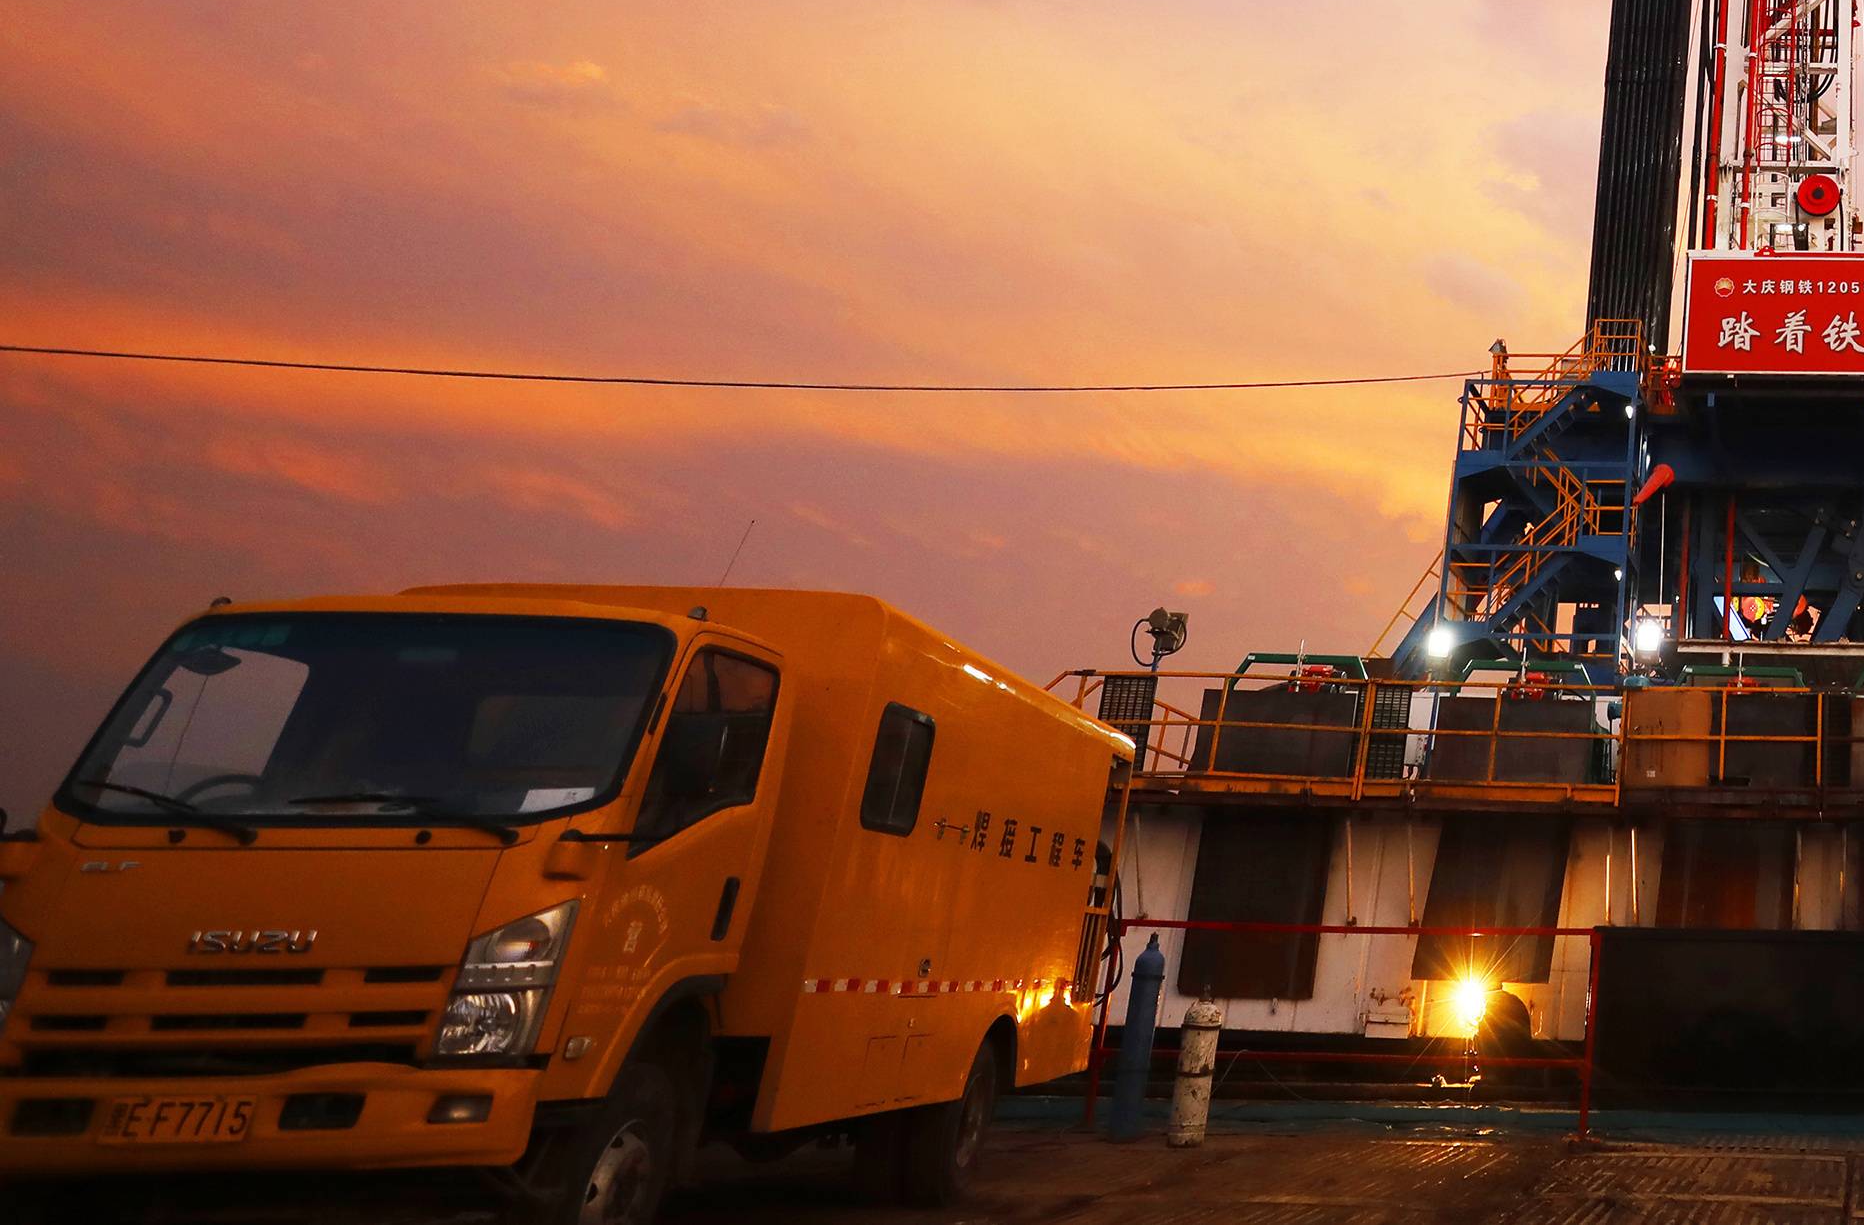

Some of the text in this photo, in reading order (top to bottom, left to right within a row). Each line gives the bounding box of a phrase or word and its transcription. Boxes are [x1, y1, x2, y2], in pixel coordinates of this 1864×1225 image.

[970, 811, 1086, 871] 焊接工程车
[189, 930, 318, 951] ISUZU
